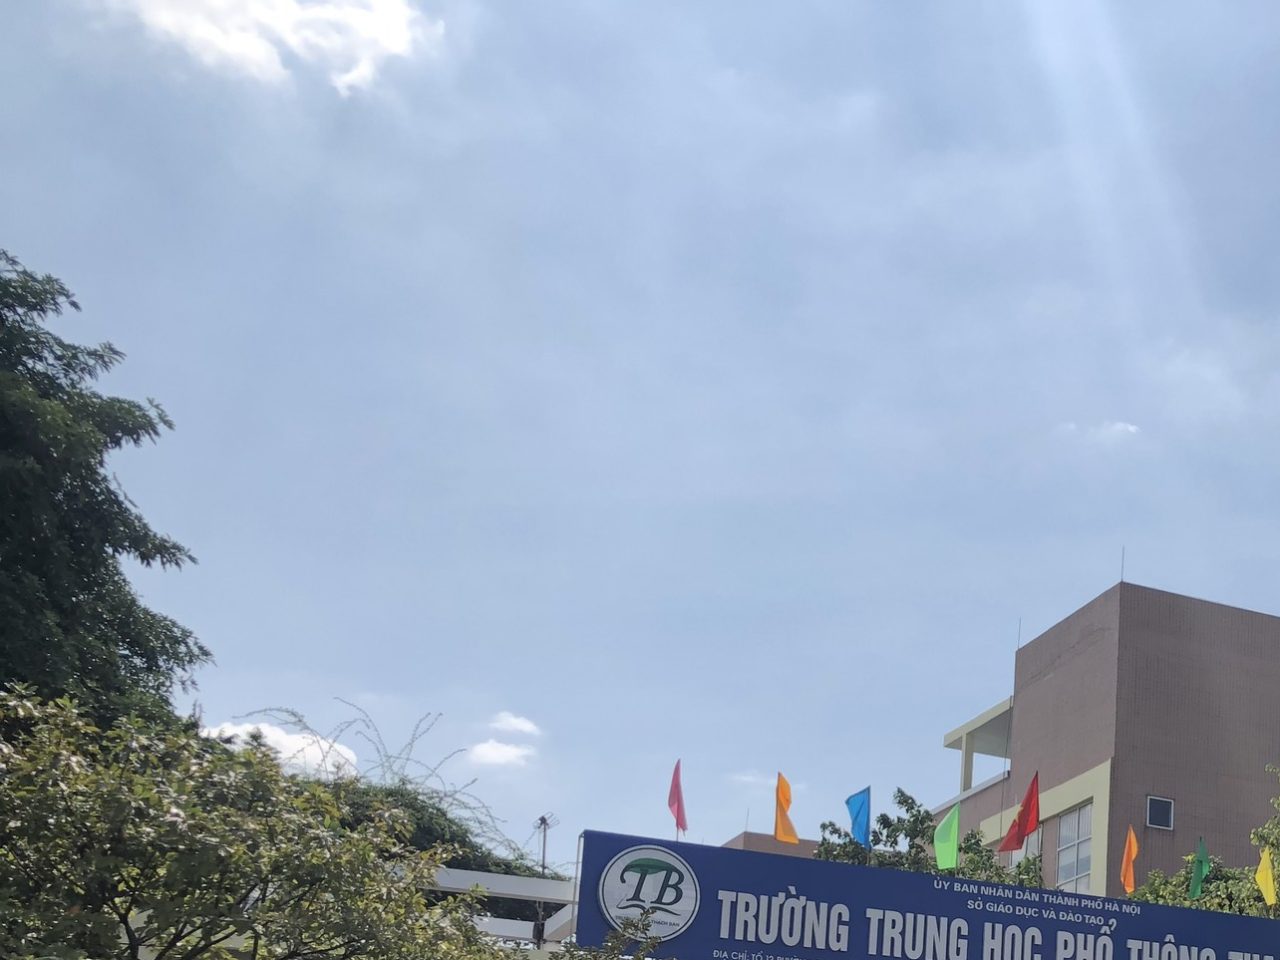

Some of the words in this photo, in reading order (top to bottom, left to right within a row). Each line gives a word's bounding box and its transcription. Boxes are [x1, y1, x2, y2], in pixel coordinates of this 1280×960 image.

[934, 877, 950, 890] ỦY
[954, 883, 978, 894] BAN
[981, 885, 1013, 898] NHÂN
[1015, 889, 1039, 901] DÂN
[1042, 893, 1079, 907] THÀNH
[1081, 897, 1104, 909] PHỐ
[1104, 901, 1119, 912] HÀ
[1122, 903, 1141, 916] NỘI
[967, 897, 983, 910] SỞ
[986, 902, 1013, 914] GIÁO
[1015, 906, 1039, 918] DỤC
[1042, 908, 1056, 919] VÀ
[1059, 910, 1082, 922] ĐÀO
[1083, 914, 1104, 926] TẠO
[717, 886, 849, 952] TRƯỜNG
[713, 950, 729, 960] ĐỊA
